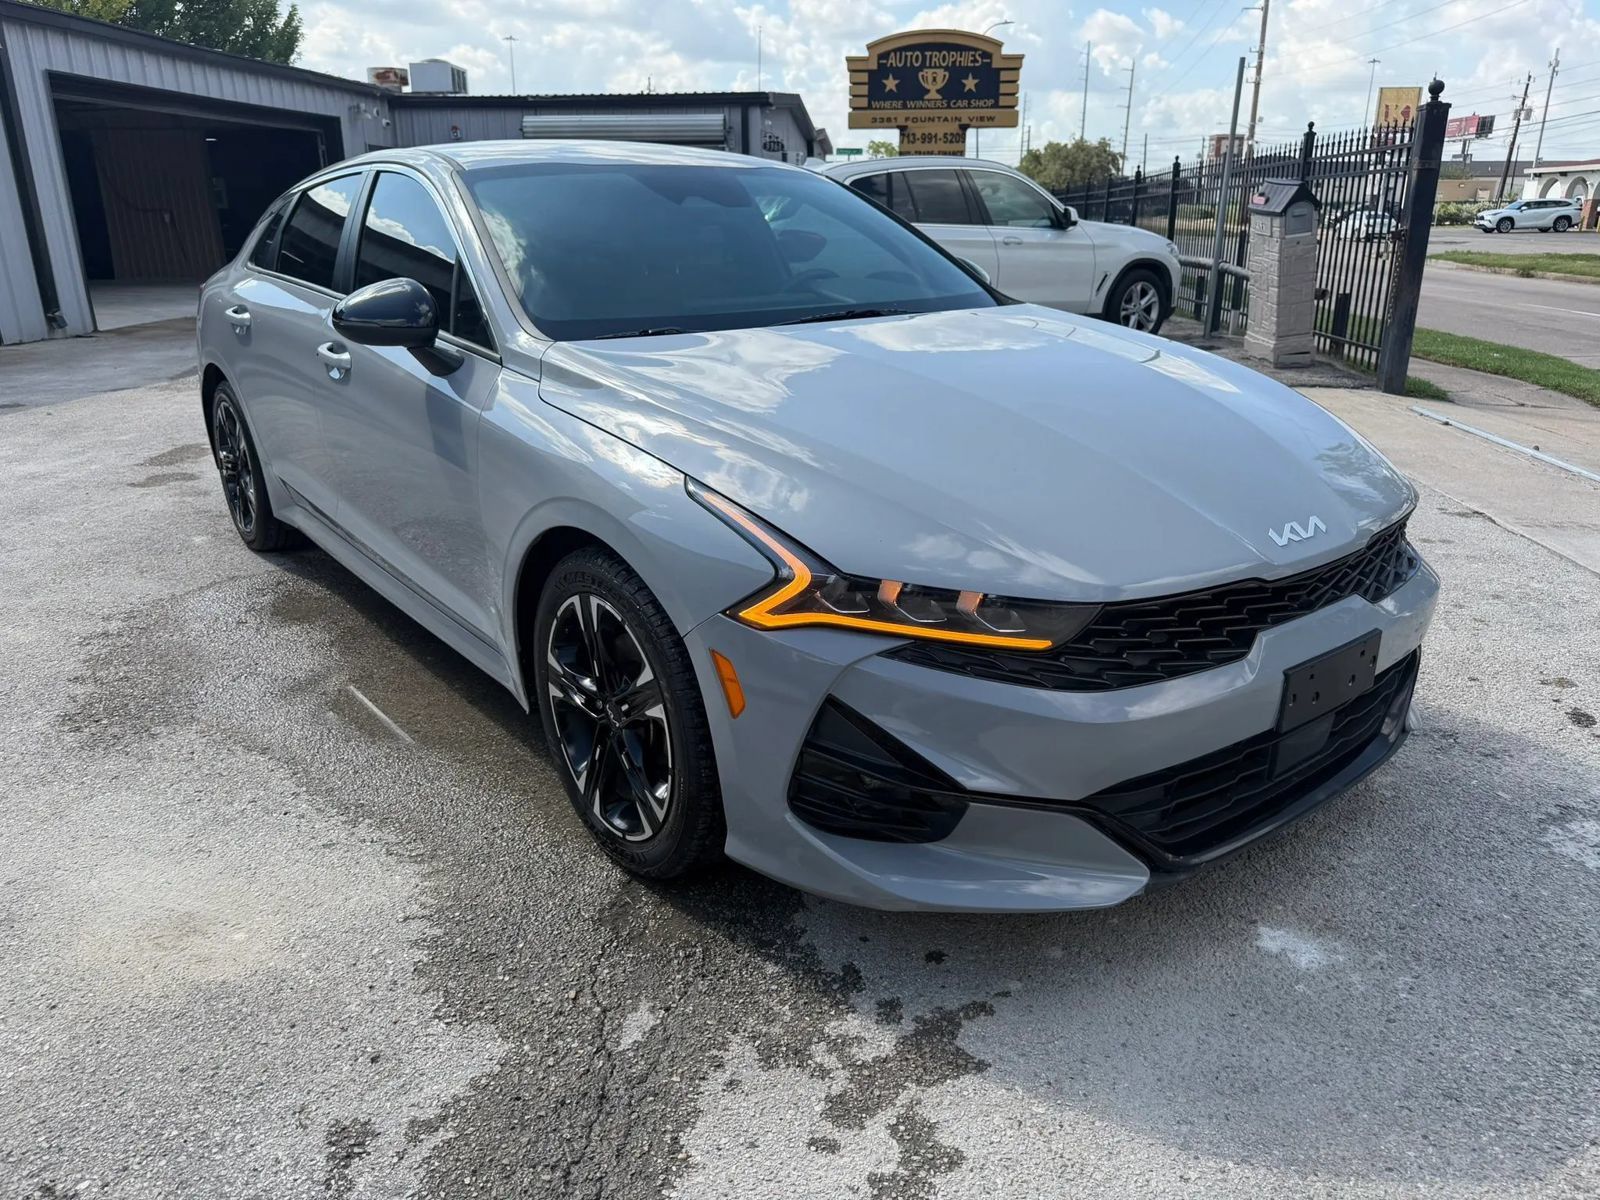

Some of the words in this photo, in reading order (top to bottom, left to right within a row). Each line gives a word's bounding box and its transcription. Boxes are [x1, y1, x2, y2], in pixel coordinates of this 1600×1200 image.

[887, 51, 922, 67] AUTO
[924, 51, 982, 67] TROPHIES
[871, 100, 904, 109] WHERE
[906, 100, 948, 108] WINNERS
[950, 100, 969, 108] CAR
[970, 99, 995, 107] SHOP
[1268, 515, 1326, 547] KIA
